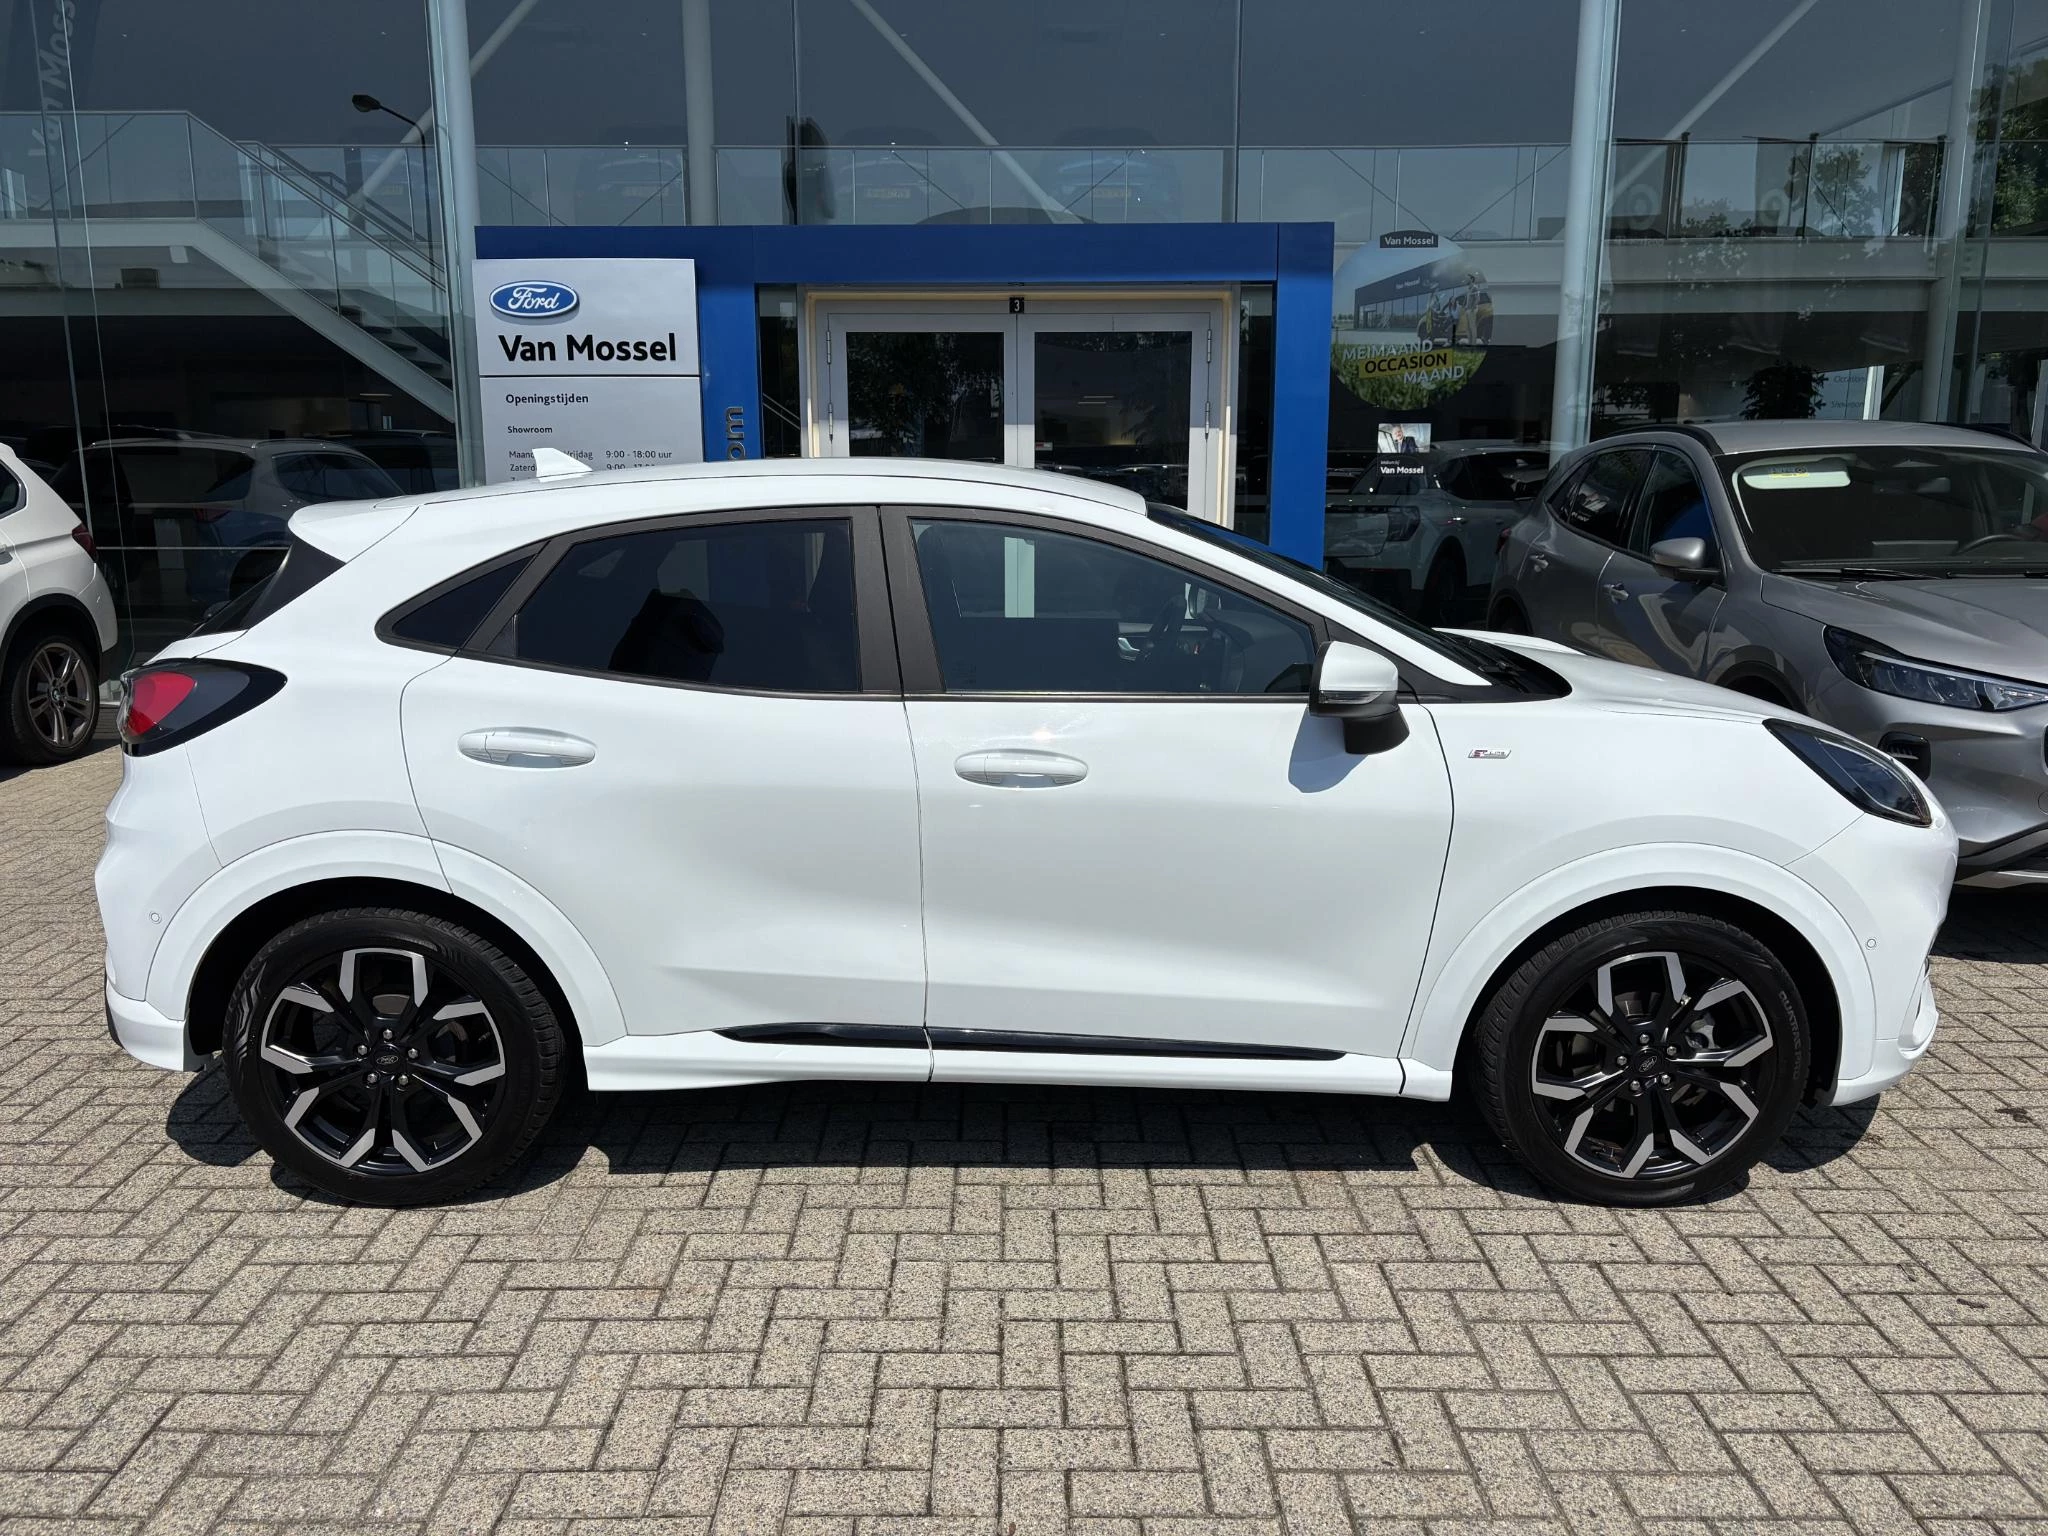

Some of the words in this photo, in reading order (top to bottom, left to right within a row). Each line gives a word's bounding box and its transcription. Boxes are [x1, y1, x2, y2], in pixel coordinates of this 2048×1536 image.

[1384, 236, 1401, 245] Van
[1403, 235, 1434, 245] Mossel
[1014, 299, 1020, 312] 3
[498, 335, 556, 361] Van
[566, 333, 676, 361] Mossel
[1365, 353, 1448, 374] OCCASION
[1403, 365, 1465, 385] MAAND
[505, 394, 589, 405] Openingstijden
[507, 425, 553, 434] Showroom
[508, 451, 534, 459] Maan
[605, 450, 626, 459] 9:00
[633, 450, 657, 459] 18:00
[509, 464, 537, 472] Zaterd
[1380, 466, 1395, 474] Van
[1396, 465, 1424, 474] Mossel
